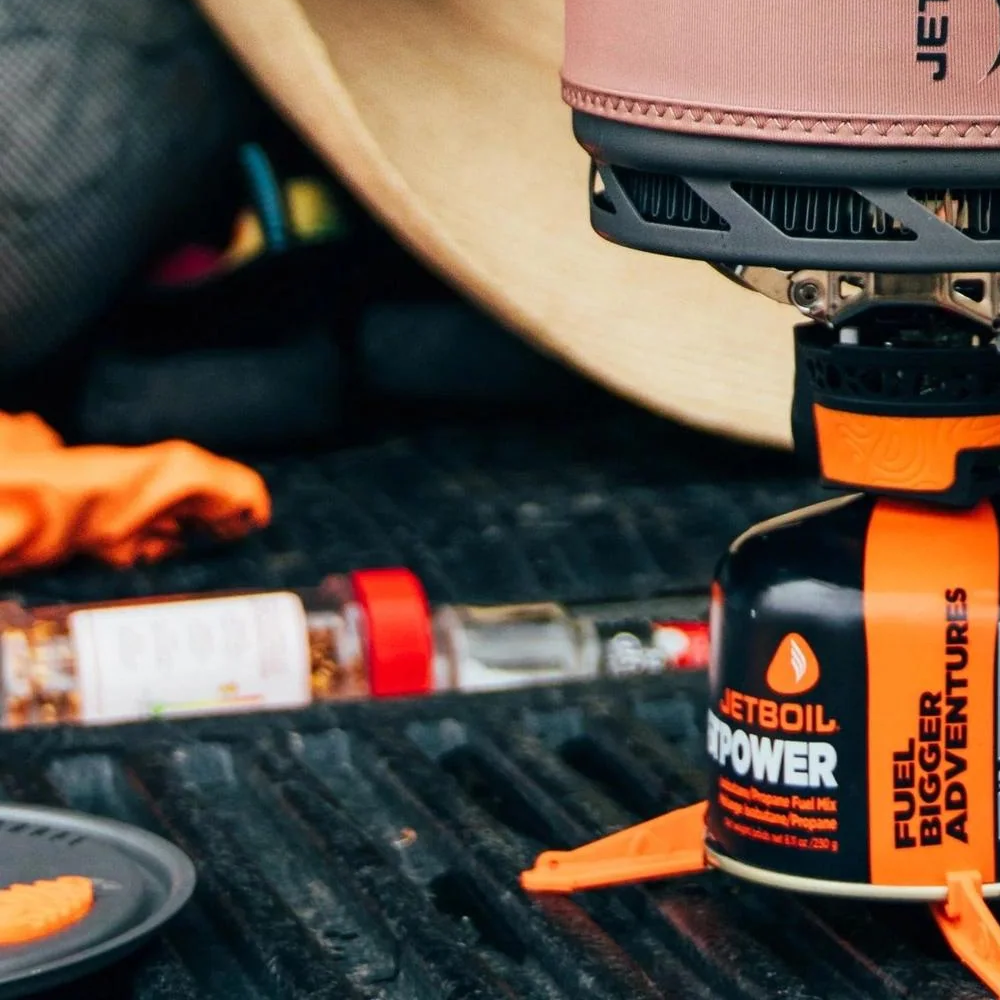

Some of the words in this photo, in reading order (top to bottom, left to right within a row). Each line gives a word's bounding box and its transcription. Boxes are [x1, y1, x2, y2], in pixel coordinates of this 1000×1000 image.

[719, 688, 838, 734] JETBOIL
[918, 690, 943, 847] BIGGER
[944, 587, 969, 845] ADVENTURES
[893, 738, 917, 850] FUEL
